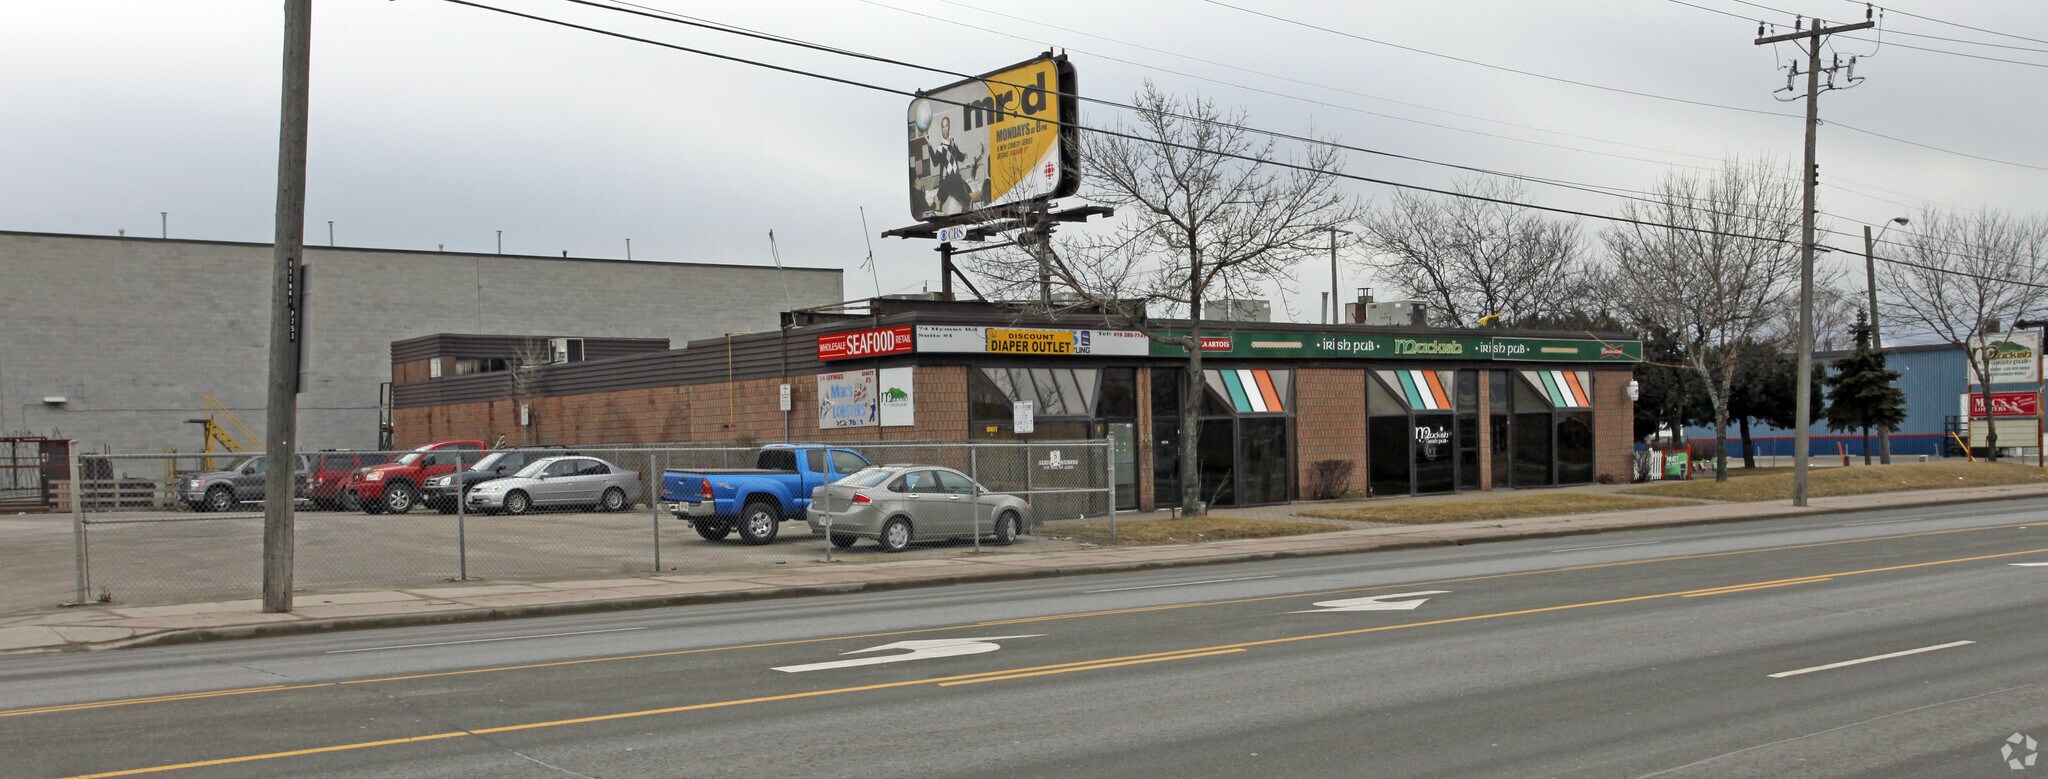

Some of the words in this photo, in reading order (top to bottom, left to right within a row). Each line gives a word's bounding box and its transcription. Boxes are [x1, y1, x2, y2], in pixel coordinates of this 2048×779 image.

[996, 123, 1030, 142] MONDAYS
[948, 226, 964, 239] CBS
[819, 341, 846, 352] WHOLESALE
[846, 330, 895, 355] SEAFOOD
[895, 334, 911, 344] RETAIL
[991, 340, 1029, 352] DIAPER
[1031, 341, 1071, 353] OUTLET
